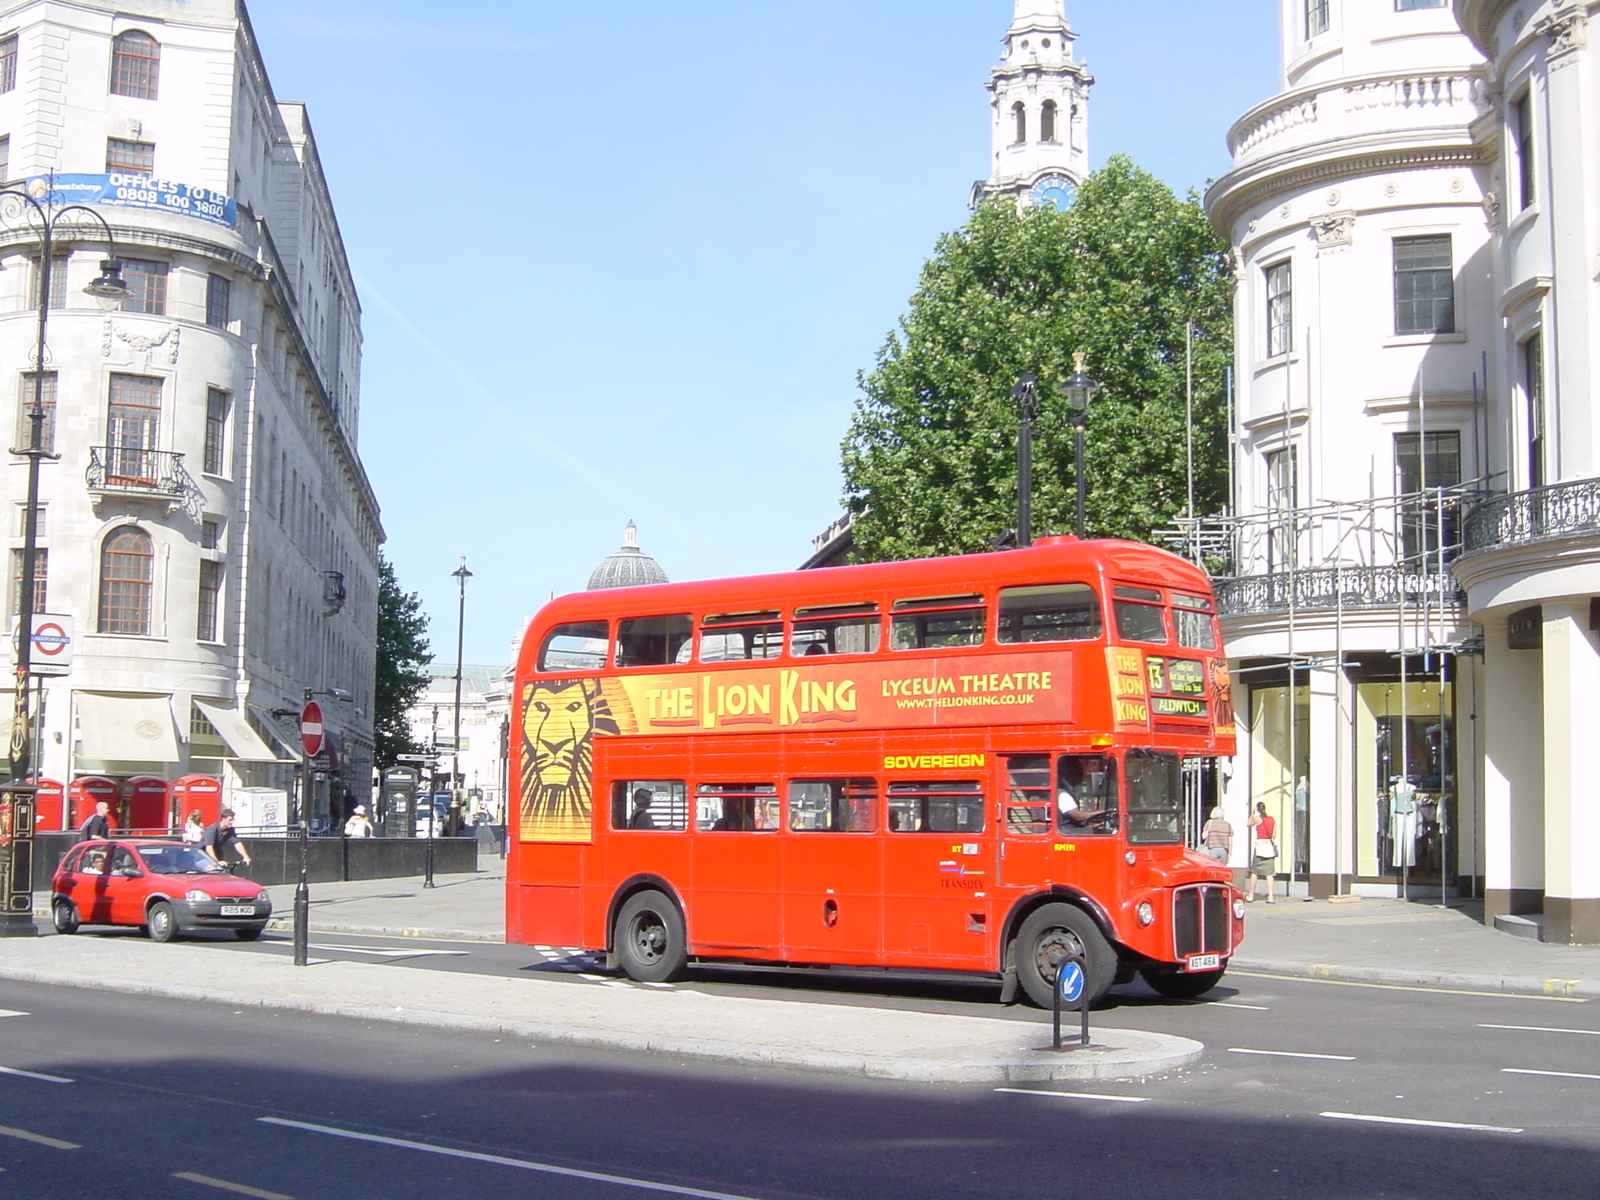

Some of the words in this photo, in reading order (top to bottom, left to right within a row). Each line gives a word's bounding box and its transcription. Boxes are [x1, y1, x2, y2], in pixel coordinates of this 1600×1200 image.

[72, 183, 102, 192] Exchange
[109, 174, 178, 194] OFFICES
[184, 184, 205, 200] TO
[209, 190, 231, 206] LET
[116, 187, 158, 203] 0808
[164, 193, 190, 208] 100
[1116, 655, 1138, 672] THE
[881, 677, 957, 697] LYCEUM
[959, 671, 1052, 693] THEATRE
[1149, 665, 1163, 689] 13
[1113, 675, 1145, 696] LION
[645, 687, 694, 719] THE
[703, 676, 771, 729] LION
[779, 669, 858, 727] KING
[896, 694, 1034, 709] WWW.THELIONKING.CO.UK
[1158, 699, 1200, 713] ALDWYCH
[1115, 700, 1147, 722] KING
[883, 754, 985, 769] SOVEREIGN
[952, 845, 962, 853] BT
[1054, 843, 1075, 852] RM191
[940, 878, 985, 889] TRANSDEV
[1191, 957, 1203, 968] AST
